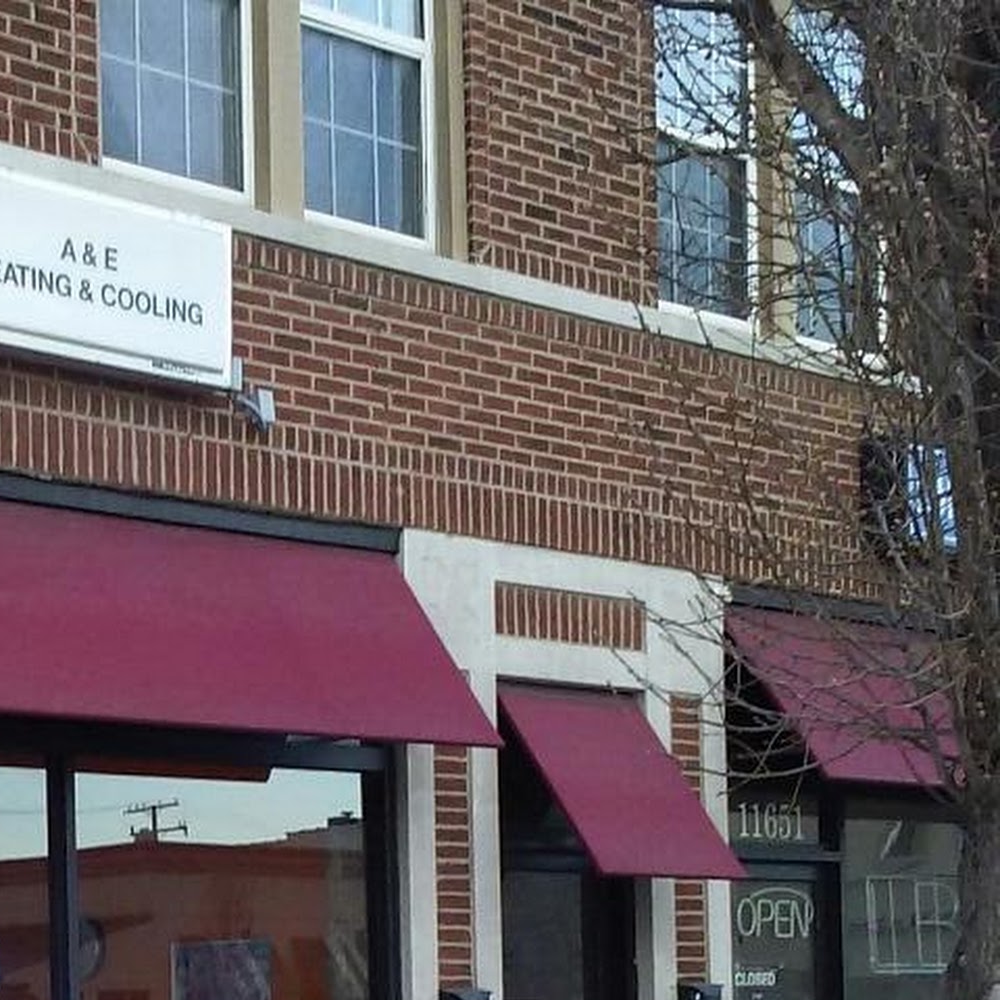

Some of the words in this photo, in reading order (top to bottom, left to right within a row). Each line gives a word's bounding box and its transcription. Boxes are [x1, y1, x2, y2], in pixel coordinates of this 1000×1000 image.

[61, 238, 76, 262] A
[82, 242, 97, 267] &
[105, 247, 118, 271] E
[79, 279, 93, 303] &
[101, 283, 204, 326] COOLING
[738, 803, 804, 841] 11651
[737, 898, 809, 938] OPEN
[735, 971, 776, 986] CLOSED
